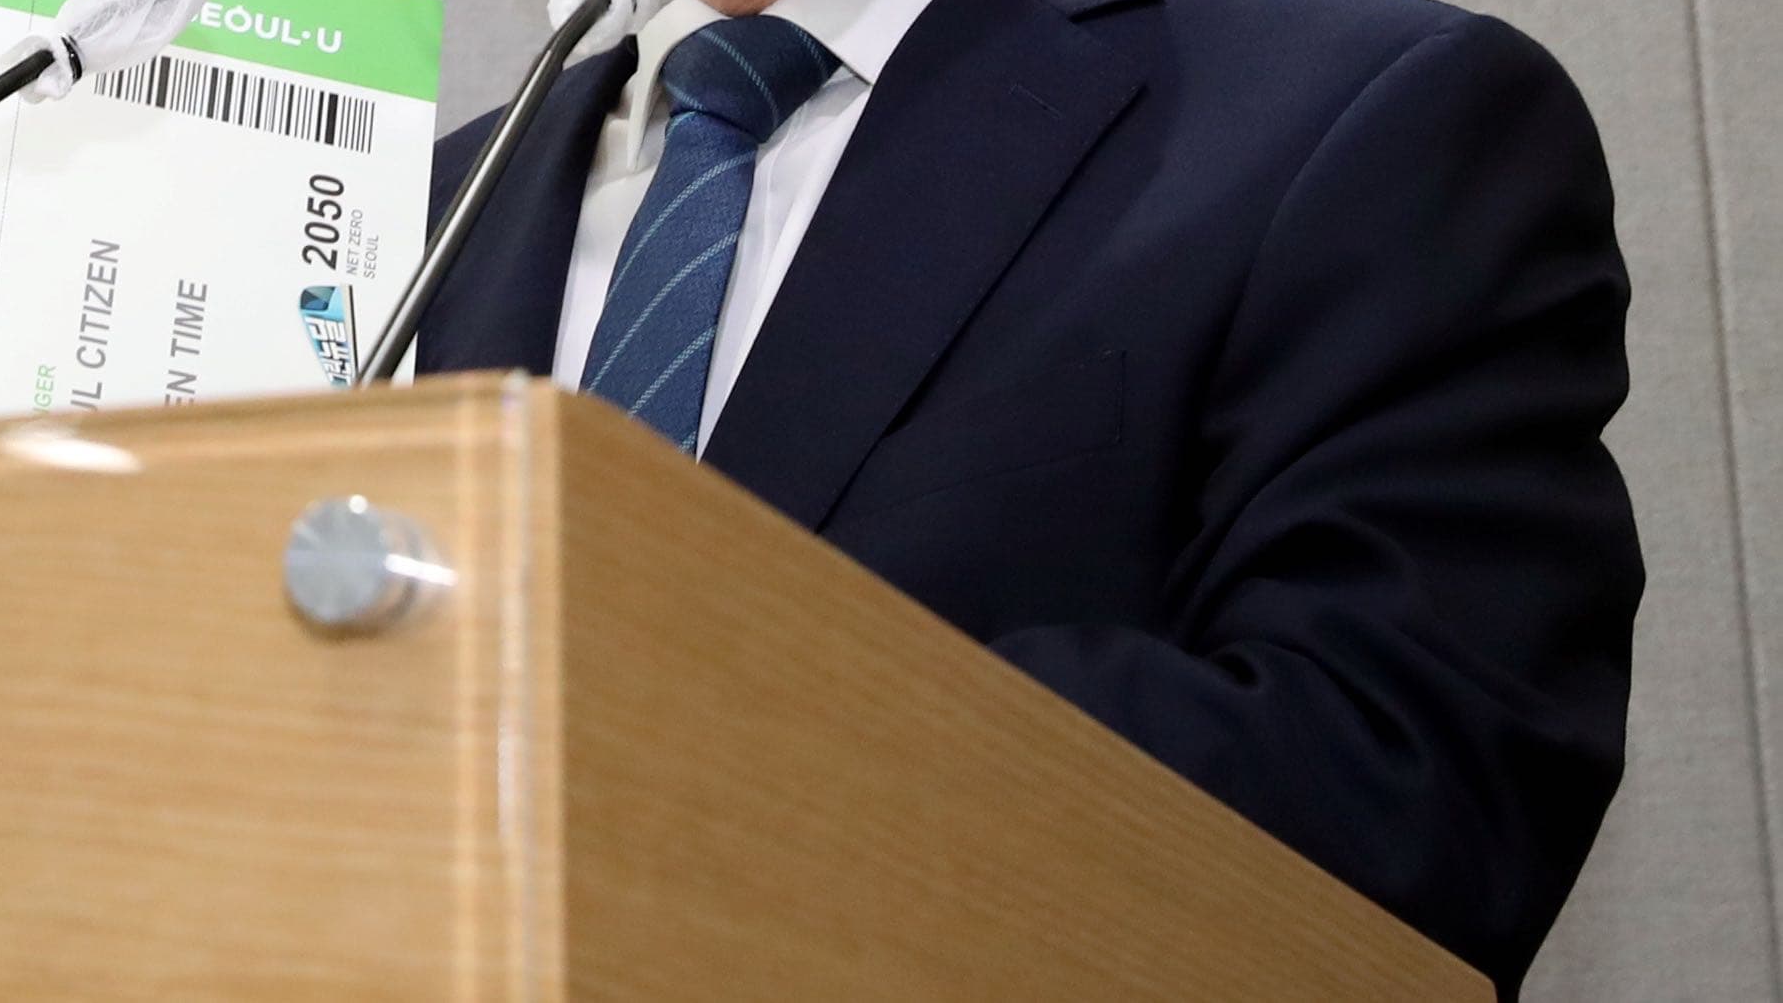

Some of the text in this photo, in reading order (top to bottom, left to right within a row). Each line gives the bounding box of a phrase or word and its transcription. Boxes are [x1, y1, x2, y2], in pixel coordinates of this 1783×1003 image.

[301, 173, 345, 271] 2050
[346, 208, 364, 276] NET ZERO
[363, 234, 379, 280] SEOUL
[76, 239, 120, 369] CITIZEN
[170, 279, 208, 357] TIME
